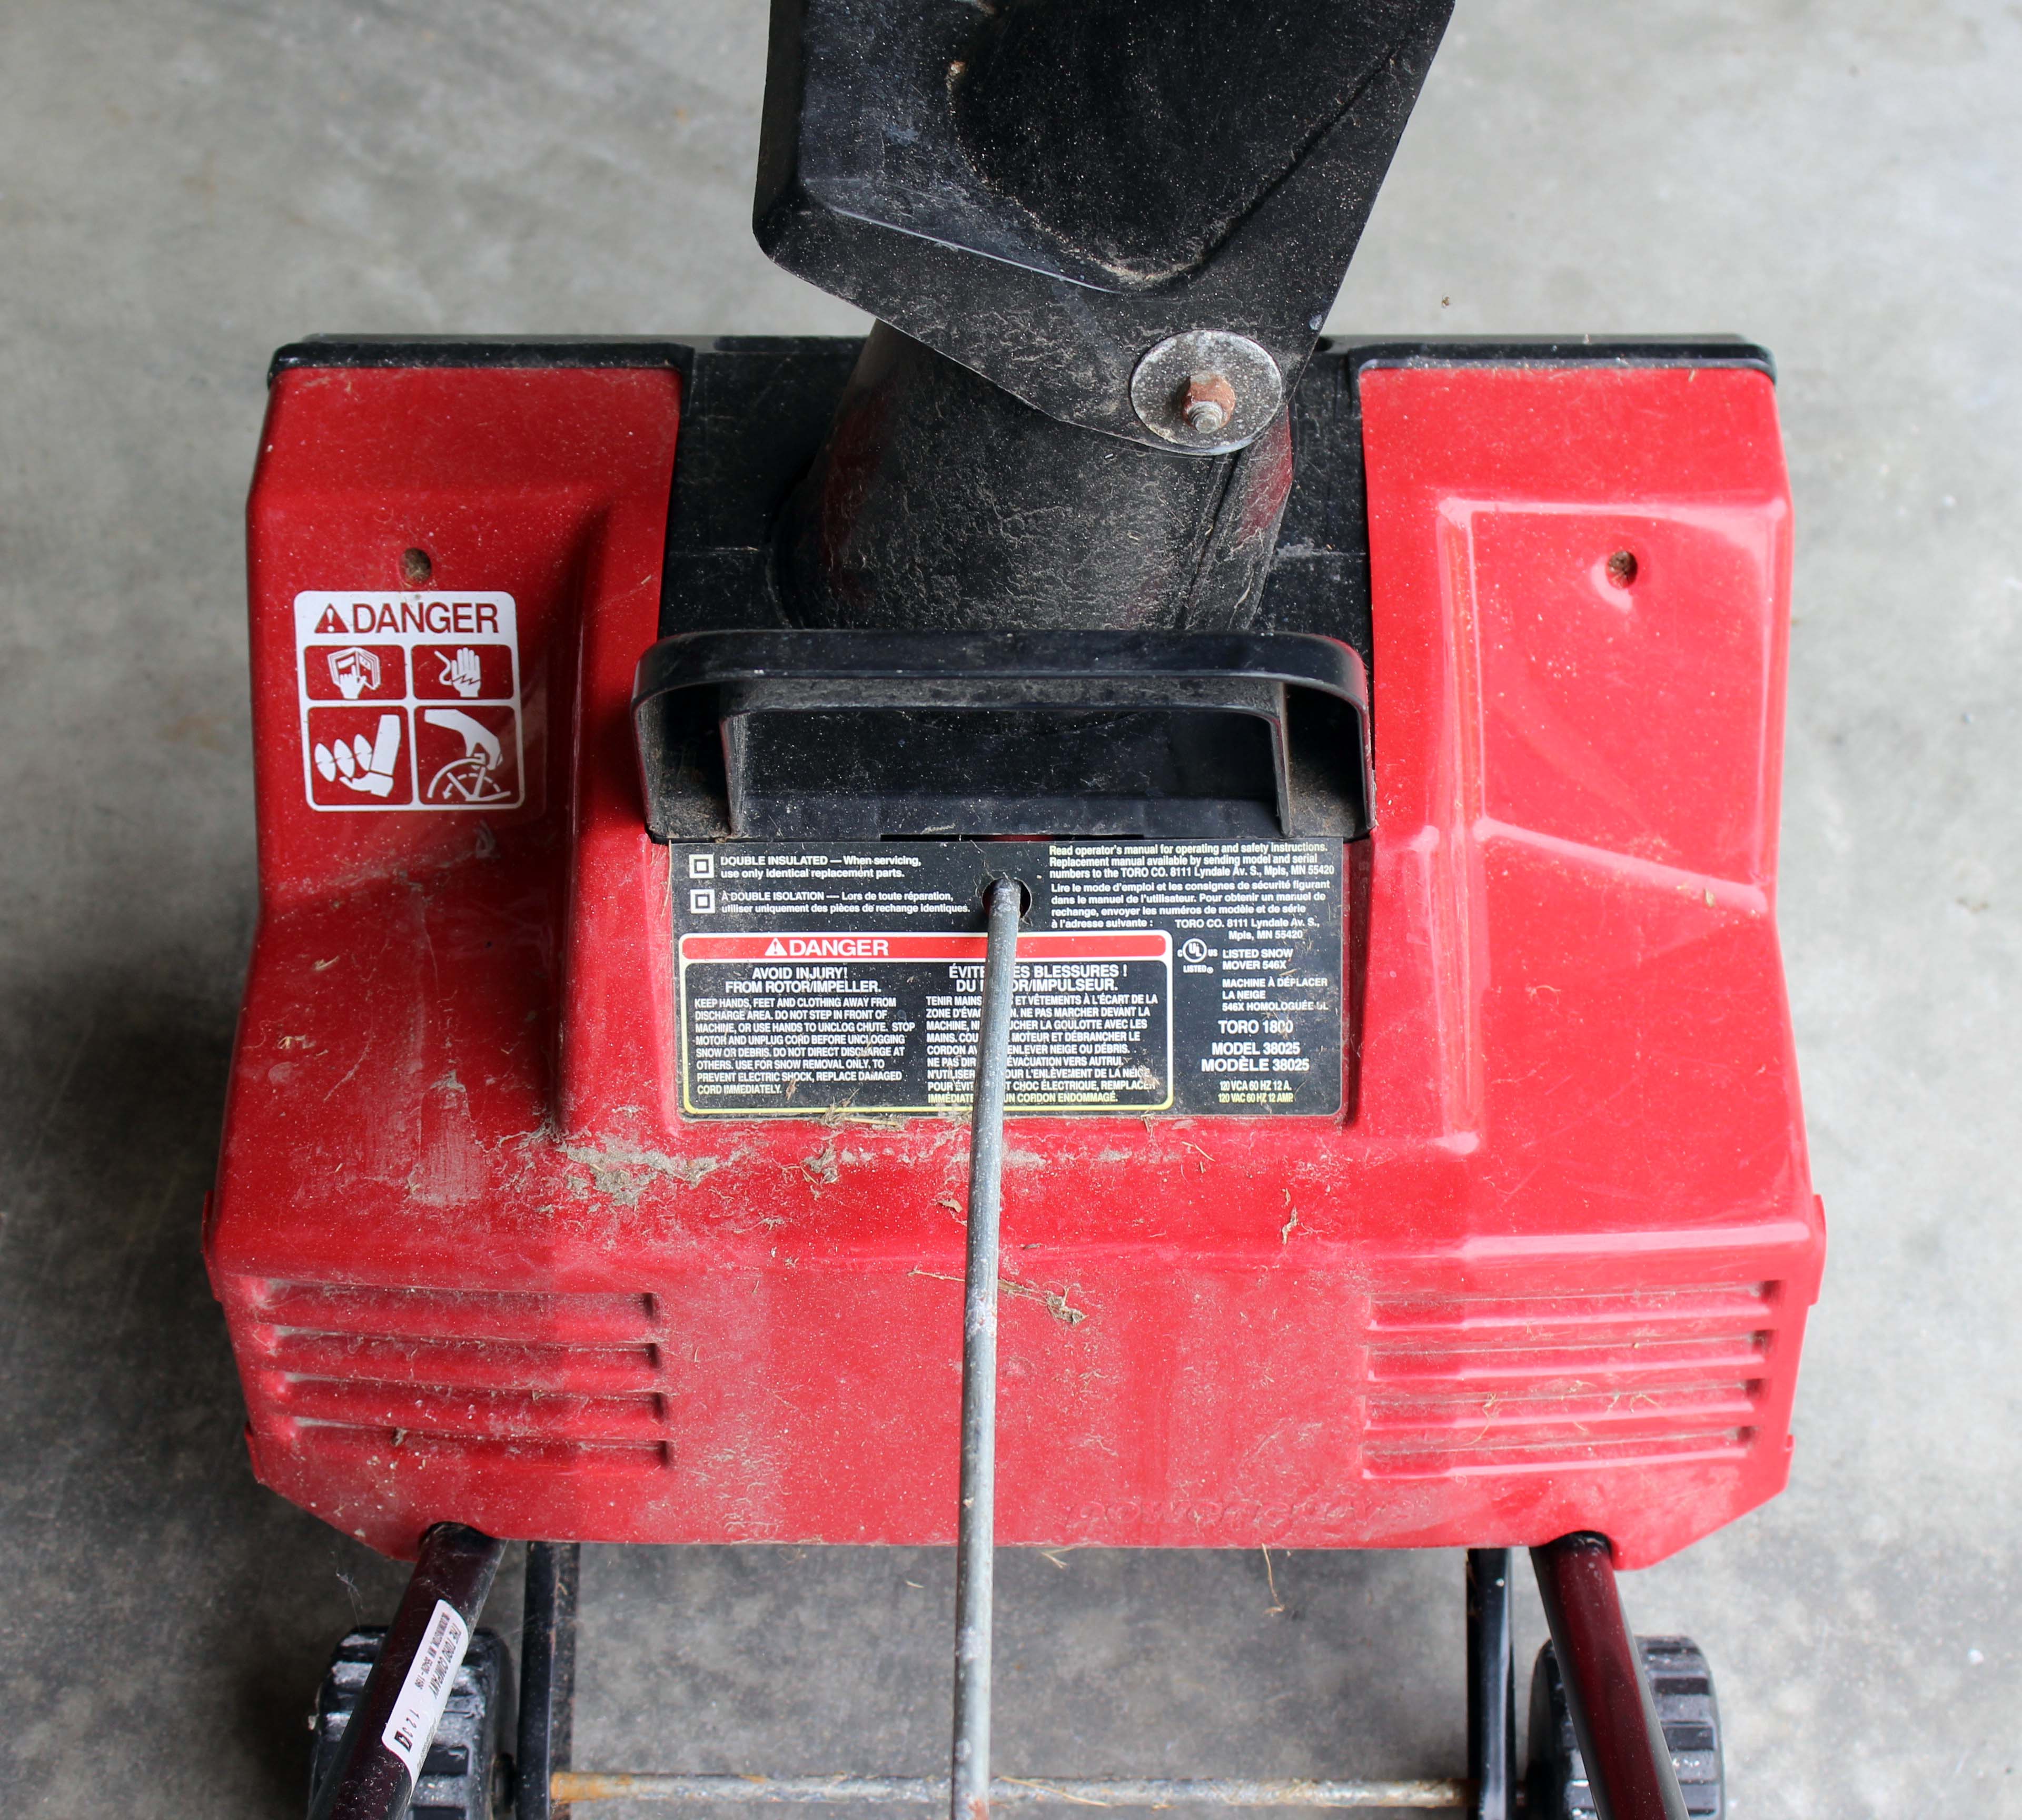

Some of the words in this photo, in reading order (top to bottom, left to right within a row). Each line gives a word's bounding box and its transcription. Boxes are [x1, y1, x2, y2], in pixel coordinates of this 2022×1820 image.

[353, 603, 499, 633] DANGER
[1049, 846, 1073, 855] Read
[1124, 845, 1158, 854] manual
[1160, 845, 1173, 854] for
[1175, 844, 1219, 856] operating
[1221, 844, 1238, 853] and
[1241, 844, 1268, 855] safety
[721, 857, 765, 865] DOUBLE
[768, 856, 828, 865] INSULATED
[843, 856, 873, 865] When
[741, 869, 764, 879] only
[766, 869, 808, 877] identical
[811, 869, 874, 879] replacement
[1049, 868, 1090, 877] numbers
[1092, 868, 1102, 877] to
[1104, 868, 1118, 877] the
[1121, 868, 1149, 877] TORO
[1170, 867, 1191, 876] 8111
[1194, 867, 1230, 878] Lyndale
[1291, 866, 1306, 875] MN
[1307, 865, 1334, 874] 55420
[1051, 883, 1070, 892] Lire
[1072, 883, 1081, 892] le
[1083, 882, 1111, 892] mode
[1156, 882, 1166, 891] et
[1168, 882, 1183, 890] les
[1185, 881, 1235, 892] consignes
[1237, 881, 1250, 889] de
[1252, 880, 1291, 889] sécurité
[1292, 879, 1330, 891] figurant
[729, 892, 770, 900] DOUBLE
[773, 892, 824, 900] ISOLATION
[841, 892, 863, 900] Lors
[864, 892, 876, 900] de
[878, 892, 902, 900] toute
[1052, 895, 1075, 904] dans
[1077, 895, 1086, 903] le
[1088, 894, 1124, 903] manuel
[1126, 894, 1138, 903] de
[1199, 893, 1223, 902] Pour
[1224, 893, 1259, 902] obtenir
[1276, 892, 1311, 901] manuel
[1313, 892, 1325, 901] de
[722, 904, 753, 912] utiliser
[755, 904, 809, 914] uniquement
[810, 904, 828, 912] des
[830, 904, 860, 914] pièces
[862, 904, 874, 912] de
[876, 903, 918, 914] rechange
[1052, 919, 1057, 927] à
[1106, 918, 1147, 927] suivante
[1175, 918, 1204, 927] TORO
[1226, 918, 1247, 927] 8111
[1251, 917, 1288, 929] Lyndale
[1256, 930, 1273, 938] MN
[1275, 929, 1303, 938] 55420
[790, 939, 888, 955] DANGER
[1222, 949, 1259, 958] LISTED
[1261, 949, 1293, 958] SNOW
[1222, 961, 1260, 970] MOVER
[1262, 961, 1286, 969] 546X
[752, 968, 792, 978] AVOID
[796, 967, 848, 978] INJURY!
[1034, 965, 1119, 977] BLESSURES
[1222, 978, 1265, 987] MACHINE
[1277, 975, 1327, 986] DÉPLACER
[726, 981, 762, 992] FROM
[1015, 996, 1026, 1005] ET
[1027, 993, 1082, 1005] VÊTEMENTS
[1131, 995, 1144, 1004] DE
[1146, 995, 1158, 1004] LA
[1222, 991, 1235, 999] LA
[1237, 991, 1266, 999] NEIGE
[695, 997, 718, 1007] KEEP
[753, 997, 775, 1007] FEET
[777, 997, 796, 1007] AND
[797, 997, 841, 1006] CLOTHING
[843, 997, 869, 1006] AWAY
[871, 997, 896, 1006] FROM
[695, 1010, 746, 1019] DISCHARGE
[775, 1010, 788, 1019] DO
[789, 1010, 808, 1019] NOT
[809, 1010, 832, 1019] STEP
[844, 1010, 873, 1019] FRONT
[875, 1010, 887, 1018] OF
[1020, 1008, 1033, 1017] NE
[1035, 1008, 1052, 1017] PAS
[1054, 1007, 1098, 1016] MARCHER
[1101, 1007, 1136, 1016] DEVANT
[1138, 1007, 1151, 1016] LA
[738, 1023, 751, 1032] OR
[752, 1022, 770, 1032] USE
[772, 1022, 802, 1032] HANDS
[804, 1022, 816, 1032] TO
[818, 1022, 855, 1031] UNCLOG
[891, 1022, 915, 1031] STOP
[1040, 1020, 1052, 1029] LA
[1054, 1020, 1102, 1029] GOULOTTE
[1104, 1020, 1128, 1028] AVEC
[1129, 1020, 1147, 1028] LES
[1218, 1020, 1259, 1033] TORO
[1263, 1020, 1293, 1033] 1800
[728, 1035, 746, 1044] AND
[748, 1035, 783, 1044] UNPLUG
[785, 1035, 809, 1044] CORD
[811, 1034, 846, 1044] BEFORE
[1212, 1042, 1260, 1055] MODEL
[1263, 1042, 1301, 1054] 38025
[1201, 1055, 1269, 1071] MODÈLE
[1272, 1059, 1310, 1071] 38025
[697, 1084, 722, 1094] CORD
[1220, 1081, 1230, 1090] 120
[1231, 1081, 1248, 1090] VCA
[1248, 1081, 1258, 1090] 60
[1260, 1081, 1271, 1090] HZ
[1273, 1081, 1282, 1090] 12
[1283, 1081, 1292, 1090] A.
[1218, 1093, 1230, 1102] 120
[1231, 1093, 1245, 1102] VAC
[1246, 1093, 1255, 1102] 60
[1256, 1093, 1266, 1102] HZ
[1268, 1093, 1275, 1102] 12
[1276, 1093, 1293, 1102] AMP.
